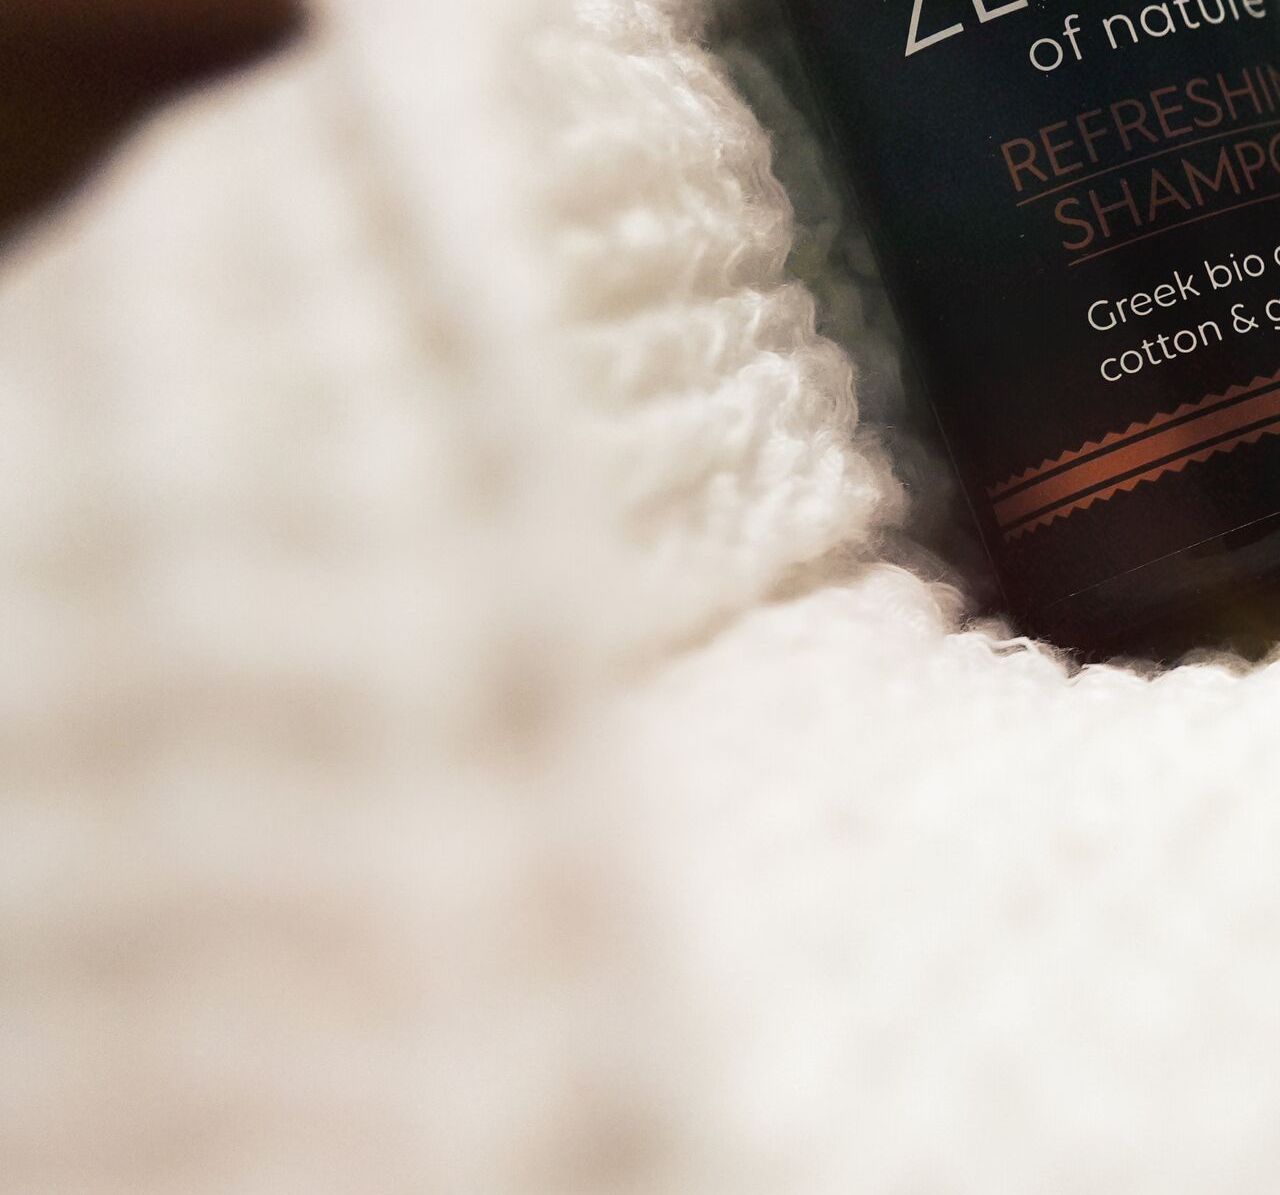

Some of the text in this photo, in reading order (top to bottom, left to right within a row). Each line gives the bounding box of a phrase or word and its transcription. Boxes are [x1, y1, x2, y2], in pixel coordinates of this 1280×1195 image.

[1028, 13, 1082, 72] of
[1086, 270, 1201, 332] Greek
[1205, 252, 1266, 290] bio
[1099, 320, 1223, 382] cotton
[1230, 303, 1259, 334] &
